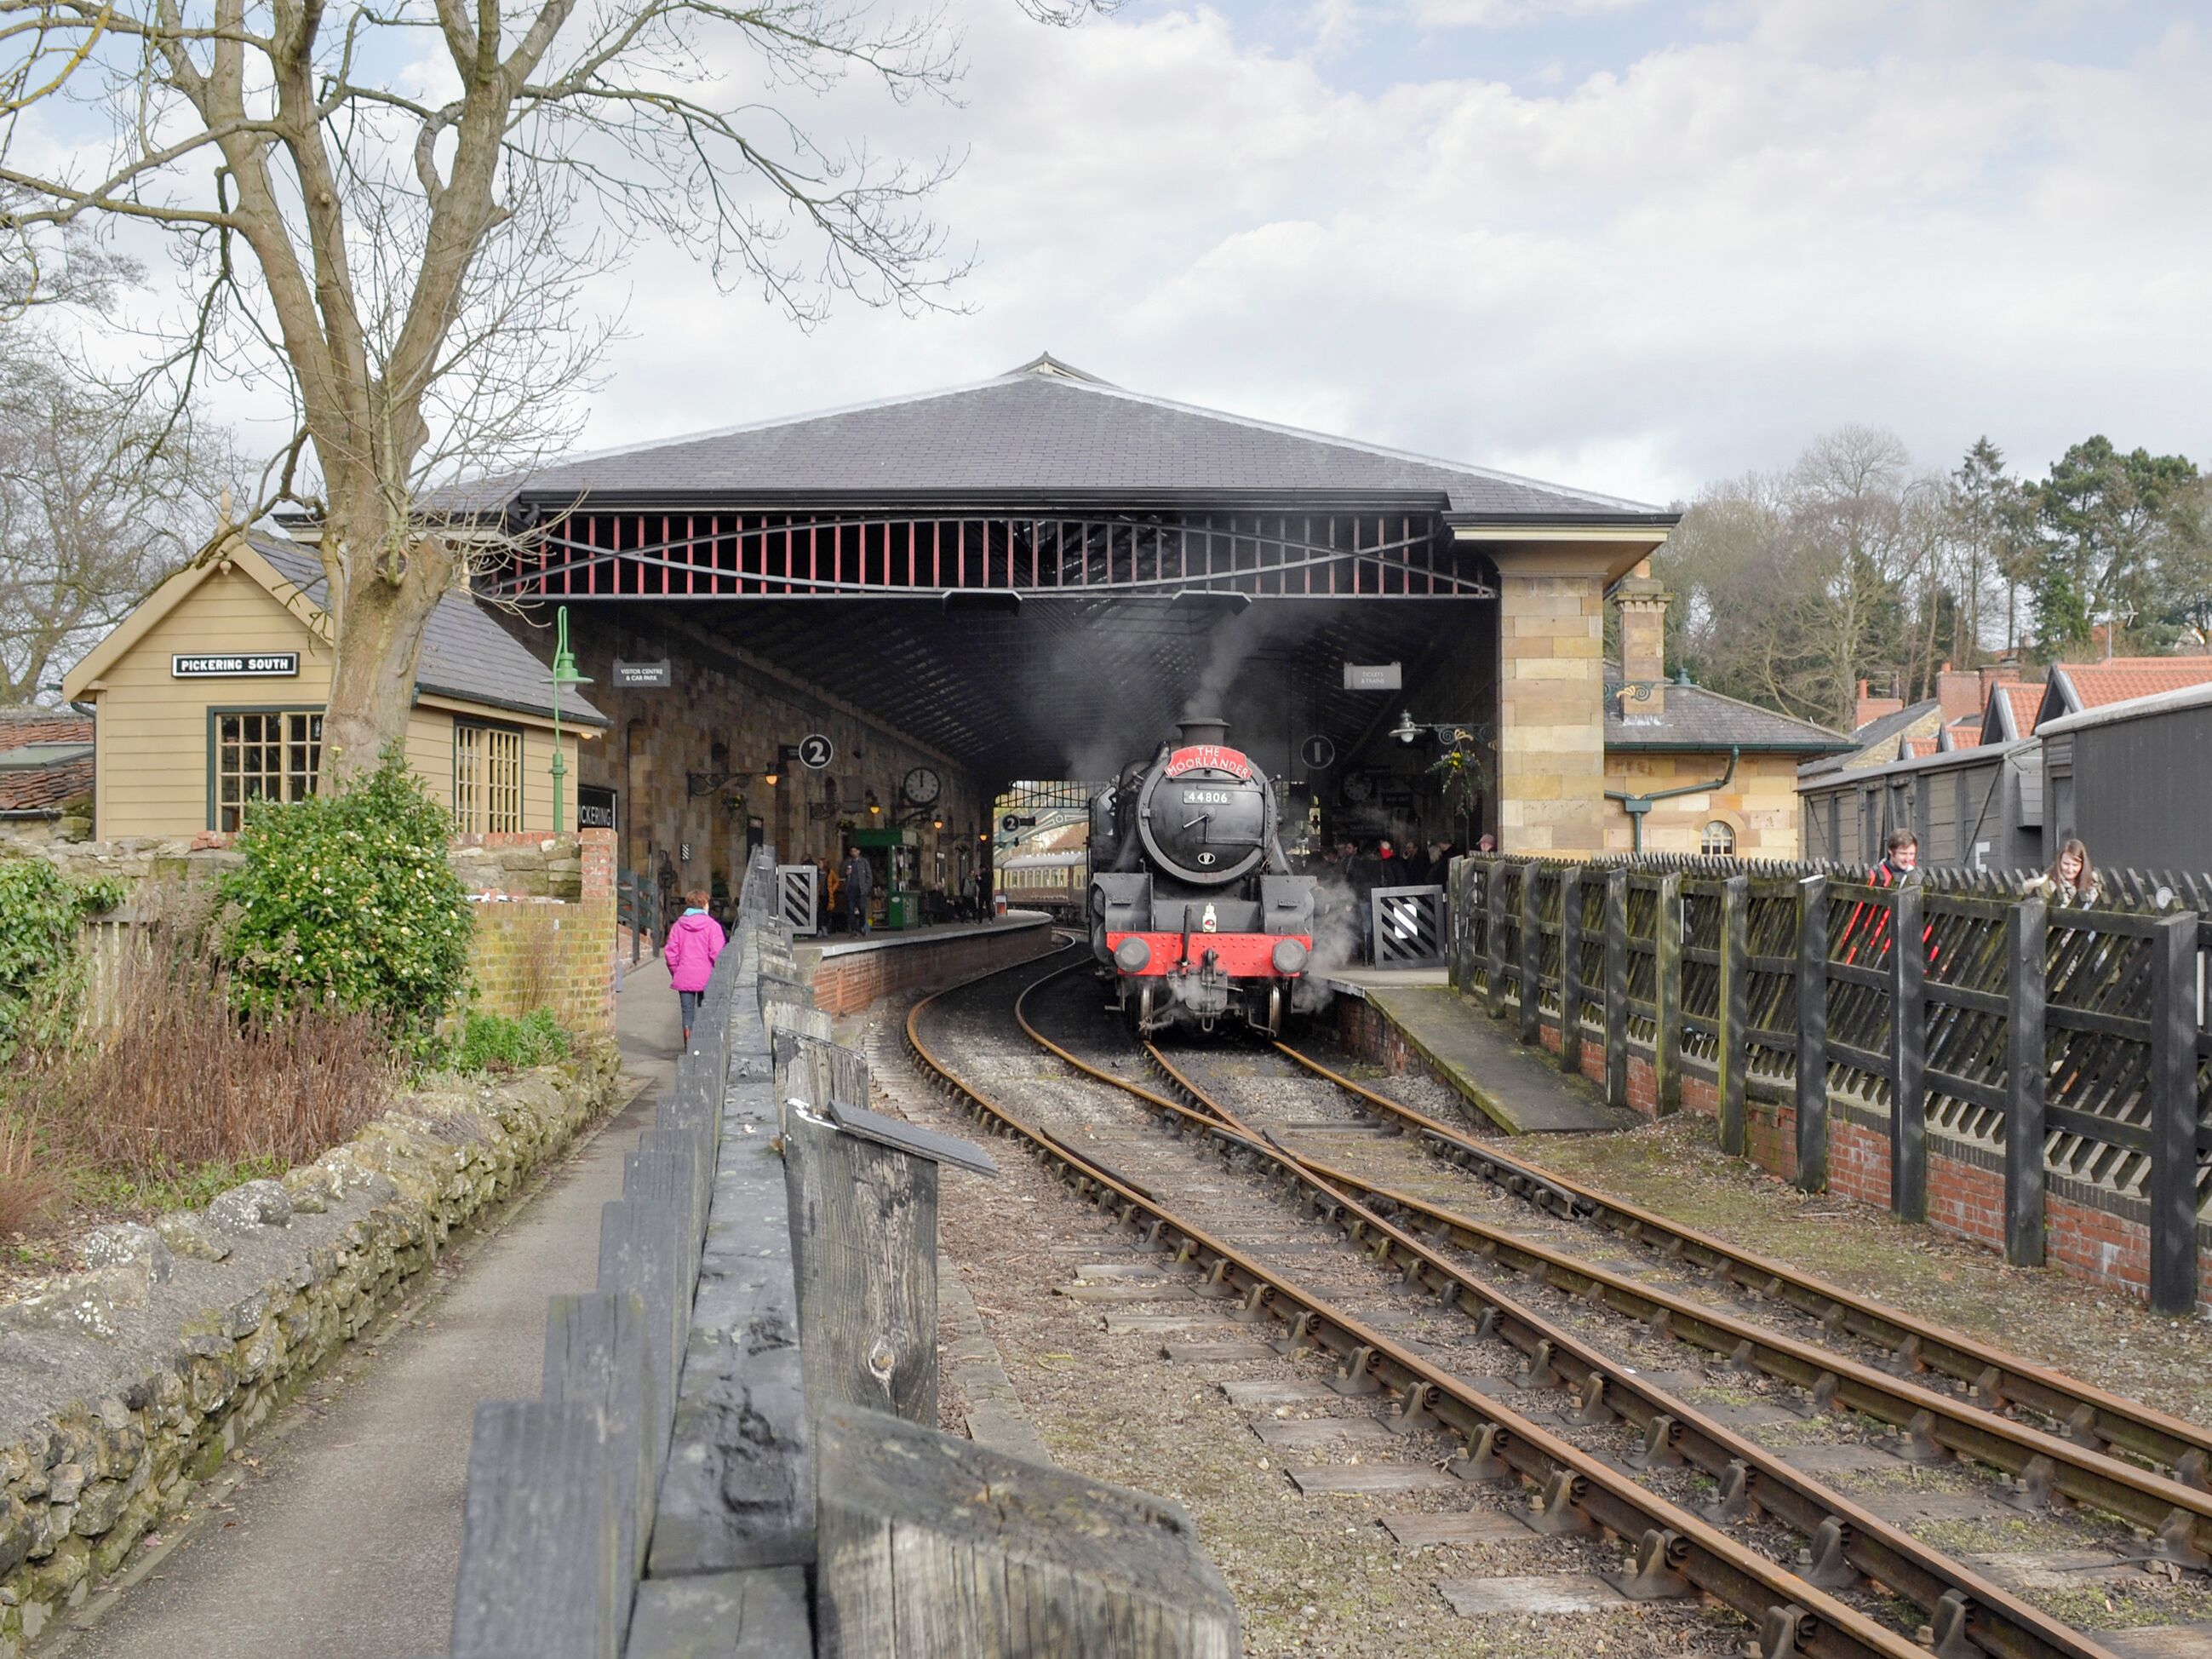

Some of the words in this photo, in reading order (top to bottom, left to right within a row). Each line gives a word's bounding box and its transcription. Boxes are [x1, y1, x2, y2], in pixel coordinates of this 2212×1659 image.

[181, 660, 243, 671] PICKERING
[248, 658, 288, 670] SOUTH
[809, 741, 825, 762] 2
[1197, 748, 1220, 756] THE
[1167, 757, 1248, 779] MOORLANDER
[1189, 792, 1228, 803] 44806
[1006, 818, 1016, 830] 2
